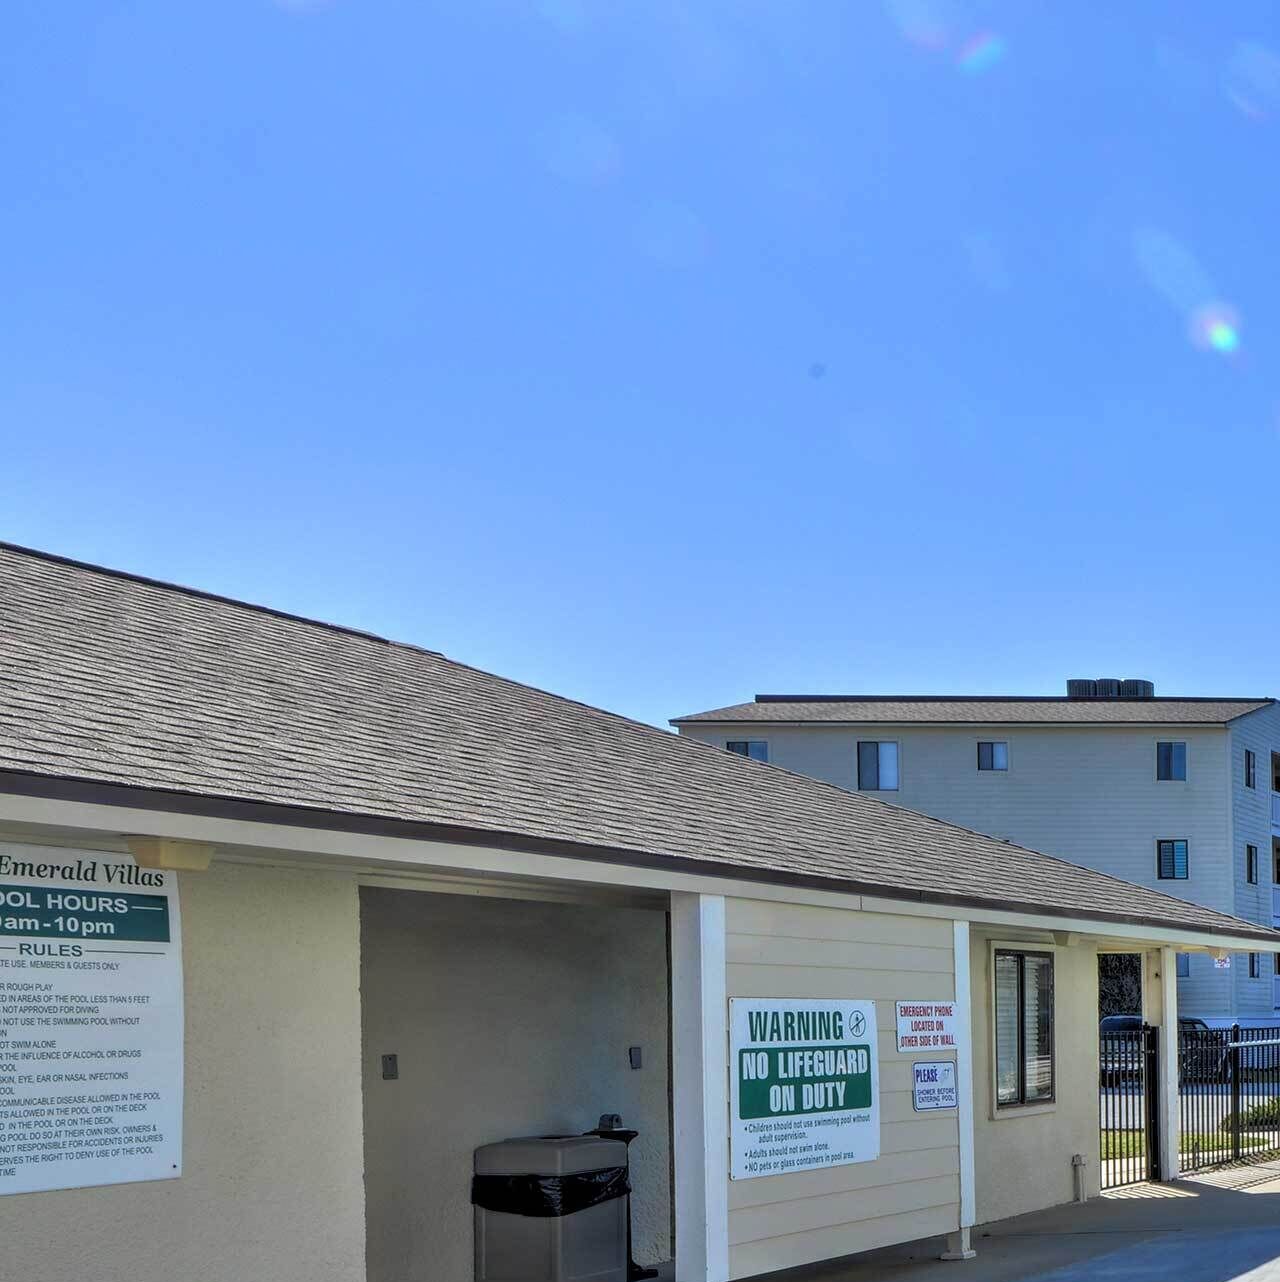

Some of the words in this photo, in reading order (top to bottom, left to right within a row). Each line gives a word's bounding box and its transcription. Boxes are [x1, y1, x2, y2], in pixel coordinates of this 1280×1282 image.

[0, 855, 97, 882] Emerald
[103, 863, 165, 888] Villas
[47, 893, 128, 914] HOURS
[18, 943, 83, 957] RULES
[30, 961, 65, 970] MEMBERS
[67, 962, 72, 970] &
[73, 962, 100, 971] GUESTS
[102, 962, 120, 971] ONLY
[7, 983, 33, 991] ROUGH
[70, 995, 89, 1003] POOL
[109, 996, 126, 1004] THAN
[133, 996, 150, 1004] FEET
[19, 1006, 58, 1014] APPROVED
[60, 1006, 74, 1014] FOR
[76, 1006, 100, 1014] DIVING
[900, 1006, 933, 1017] EMERGENCY
[934, 1006, 952, 1016] PHONE
[748, 1011, 844, 1042] WARNING
[911, 1020, 934, 1032] LOCATED
[936, 1020, 944, 1031] ON
[32, 1040, 56, 1048] ALONE
[900, 1036, 918, 1047] OTHER
[919, 1035, 932, 1046] SIDE
[932, 1034, 939, 1046] OF
[940, 1034, 954, 1045] WALL
[21, 1052, 61, 1060] INFLUENCE
[73, 1050, 104, 1059] ALCOHOL
[106, 1050, 117, 1058] OR
[118, 1050, 141, 1058] DRUGS
[742, 1052, 768, 1080] NO
[778, 1049, 868, 1078] LIFEGUARD
[52, 1074, 63, 1082] OR
[65, 1073, 86, 1082] NASAL
[89, 1072, 128, 1080] INFECTIONS
[916, 1068, 938, 1083] PLEASE
[0, 1097, 55, 1107] OMMUNICABLE
[56, 1096, 87, 1104] DISEASE
[88, 1094, 120, 1103] ALLOWED
[130, 1092, 142, 1100] THE
[144, 1092, 160, 1100] POOL
[770, 1084, 795, 1112] ON
[802, 1081, 846, 1110] DUTY
[10, 1108, 45, 1118] ALLOWED
[47, 1108, 54, 1116] IN
[56, 1107, 70, 1115] THE
[71, 1106, 90, 1115] POOL
[91, 1106, 102, 1114] OR
[103, 1105, 114, 1113] ON
[115, 1104, 128, 1112] THE
[129, 1103, 147, 1112] DECK
[9, 1122, 16, 1130] IN
[18, 1121, 32, 1129] THE
[34, 1120, 54, 1128] POOL
[55, 1119, 66, 1127] OR
[68, 1118, 78, 1126] ON
[80, 1118, 93, 1126] THE
[95, 1117, 113, 1125] DECK
[748, 1122, 772, 1133] Children
[773, 1121, 792, 1130] should
[793, 1121, 803, 1129] not
[804, 1120, 813, 1128] use
[814, 1116, 840, 1127] swimming
[841, 1114, 852, 1126] pool
[853, 1114, 870, 1122] without
[8, 1132, 28, 1141] POOL
[30, 1132, 40, 1140] DO
[42, 1131, 53, 1139] SO
[54, 1130, 62, 1139] AT
[64, 1129, 85, 1138] THEIR
[86, 1128, 103, 1136] OWN
[122, 1125, 151, 1134] OWNERS
[759, 1132, 773, 1143] adult
[17, 1141, 66, 1152] RESPONSIBLE
[68, 1140, 83, 1148] FOR
[85, 1137, 122, 1147] ACCIDENTS
[124, 1136, 134, 1144] OR
[135, 1134, 163, 1144] INJURIES
[25, 1155, 39, 1163] THE
[41, 1153, 63, 1162] RIGHT
[64, 1152, 74, 1160] TO
[76, 1151, 94, 1160] DENY
[96, 1149, 110, 1158] USE
[111, 1148, 120, 1157] OF
[122, 1148, 134, 1156] THE
[136, 1146, 153, 1154] POOL
[748, 1148, 768, 1159] Adults
[769, 1146, 788, 1157] should
[789, 1145, 798, 1154] not
[799, 1144, 813, 1153] swim
[748, 1161, 758, 1171] NO
[759, 1161, 772, 1173] pets
[780, 1158, 795, 1170] glass
[796, 1154, 824, 1166] containers
[825, 1153, 830, 1162] in
[831, 1151, 842, 1163] pool
